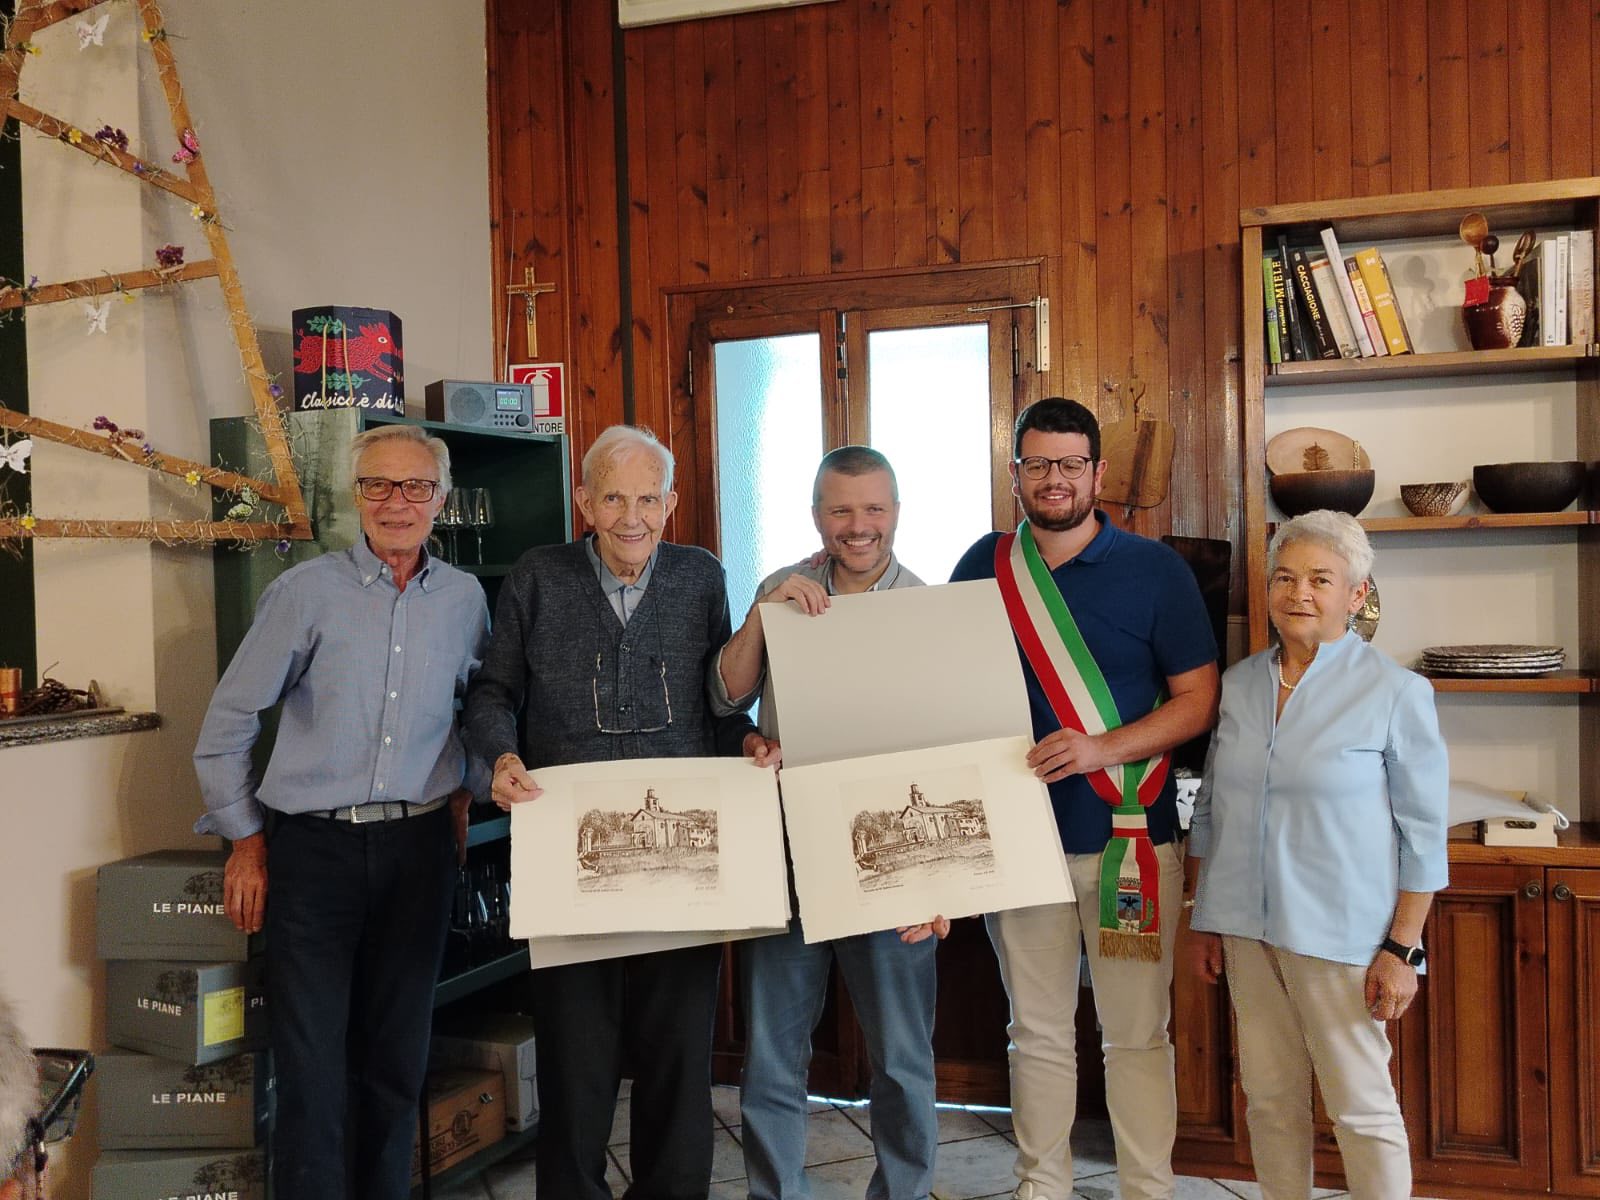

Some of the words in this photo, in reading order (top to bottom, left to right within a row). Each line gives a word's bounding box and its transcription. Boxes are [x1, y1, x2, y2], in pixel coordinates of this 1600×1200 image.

[1272, 260, 1285, 298] MIELE
[1297, 264, 1321, 321] CACCIAGIONE
[356, 392, 370, 408] è
[371, 392, 394, 409] di
[153, 902, 171, 913] LE
[177, 903, 225, 915] PIANE
[138, 997, 149, 1009] LE
[151, 1001, 182, 1016] PIANE
[152, 1093, 170, 1104] LE
[176, 1092, 226, 1103] PIANE
